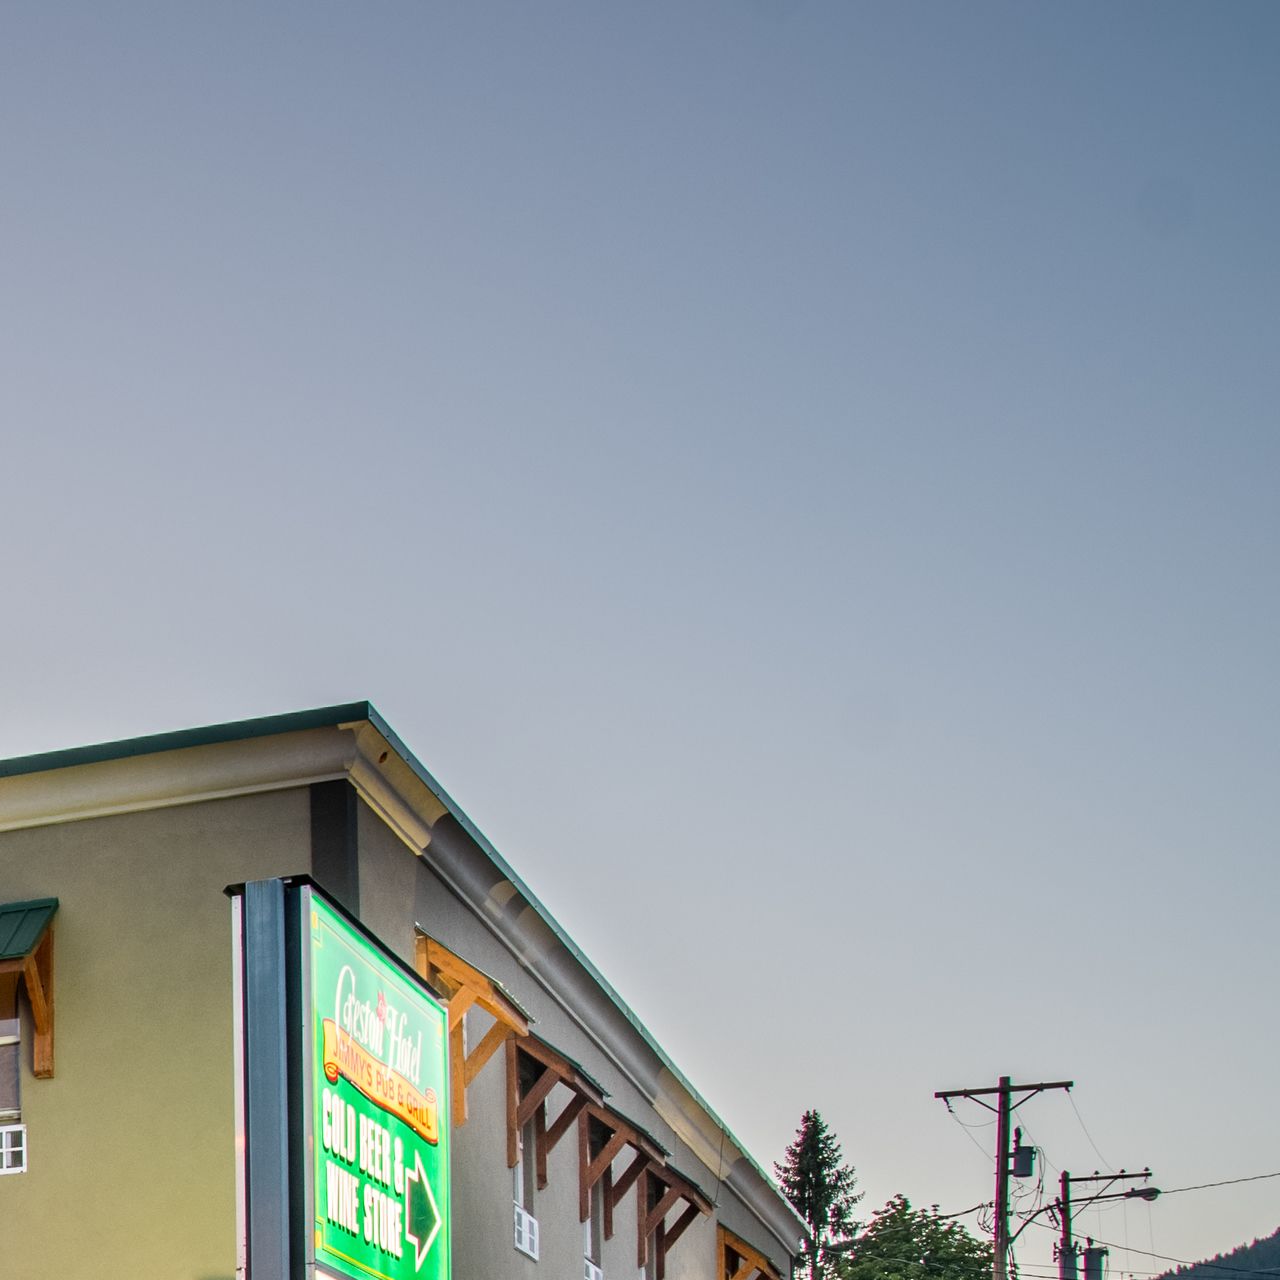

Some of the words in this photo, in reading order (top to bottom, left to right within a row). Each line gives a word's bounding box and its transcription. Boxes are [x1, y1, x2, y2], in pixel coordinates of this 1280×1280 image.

[335, 965, 384, 1057] Creston
[384, 1005, 422, 1085] Hotel
[322, 1087, 356, 1166] COLD
[359, 1112, 391, 1188] BEER
[394, 1136, 404, 1196] &
[376, 1069, 395, 1101] PUB
[407, 1092, 431, 1130] GRILL
[326, 1159, 360, 1237] WINE
[363, 1183, 403, 1260] STORE
